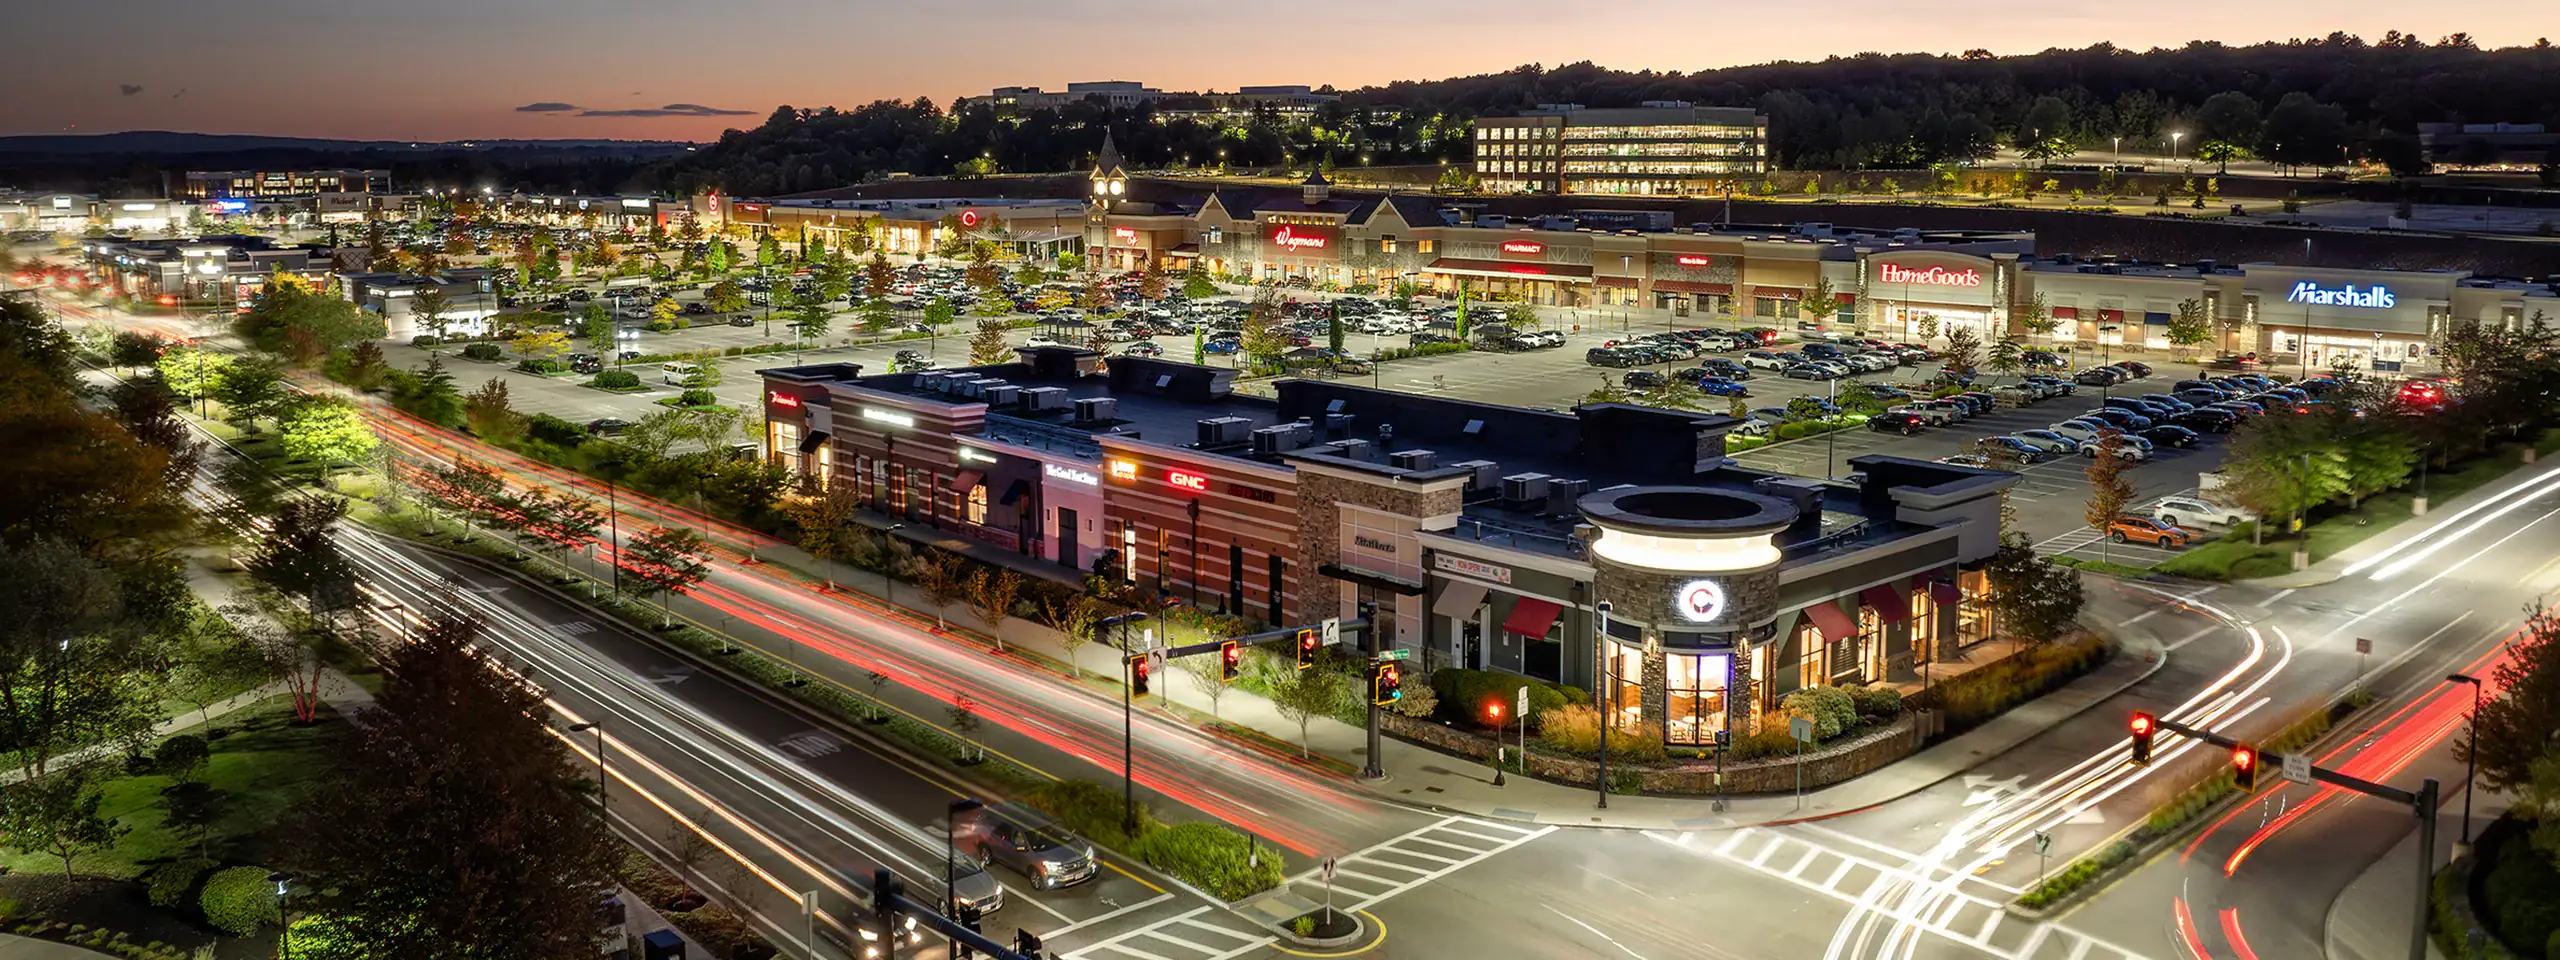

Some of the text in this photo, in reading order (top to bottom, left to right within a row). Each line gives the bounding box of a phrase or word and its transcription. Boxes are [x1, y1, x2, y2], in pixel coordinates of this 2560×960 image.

[1275, 226, 1325, 252] Wegmans
[1504, 244, 1541, 253] PHARMACY
[1881, 264, 1980, 287] HomeGoods
[2288, 282, 2395, 308] Marshalls
[1170, 472, 1205, 490] GNC
